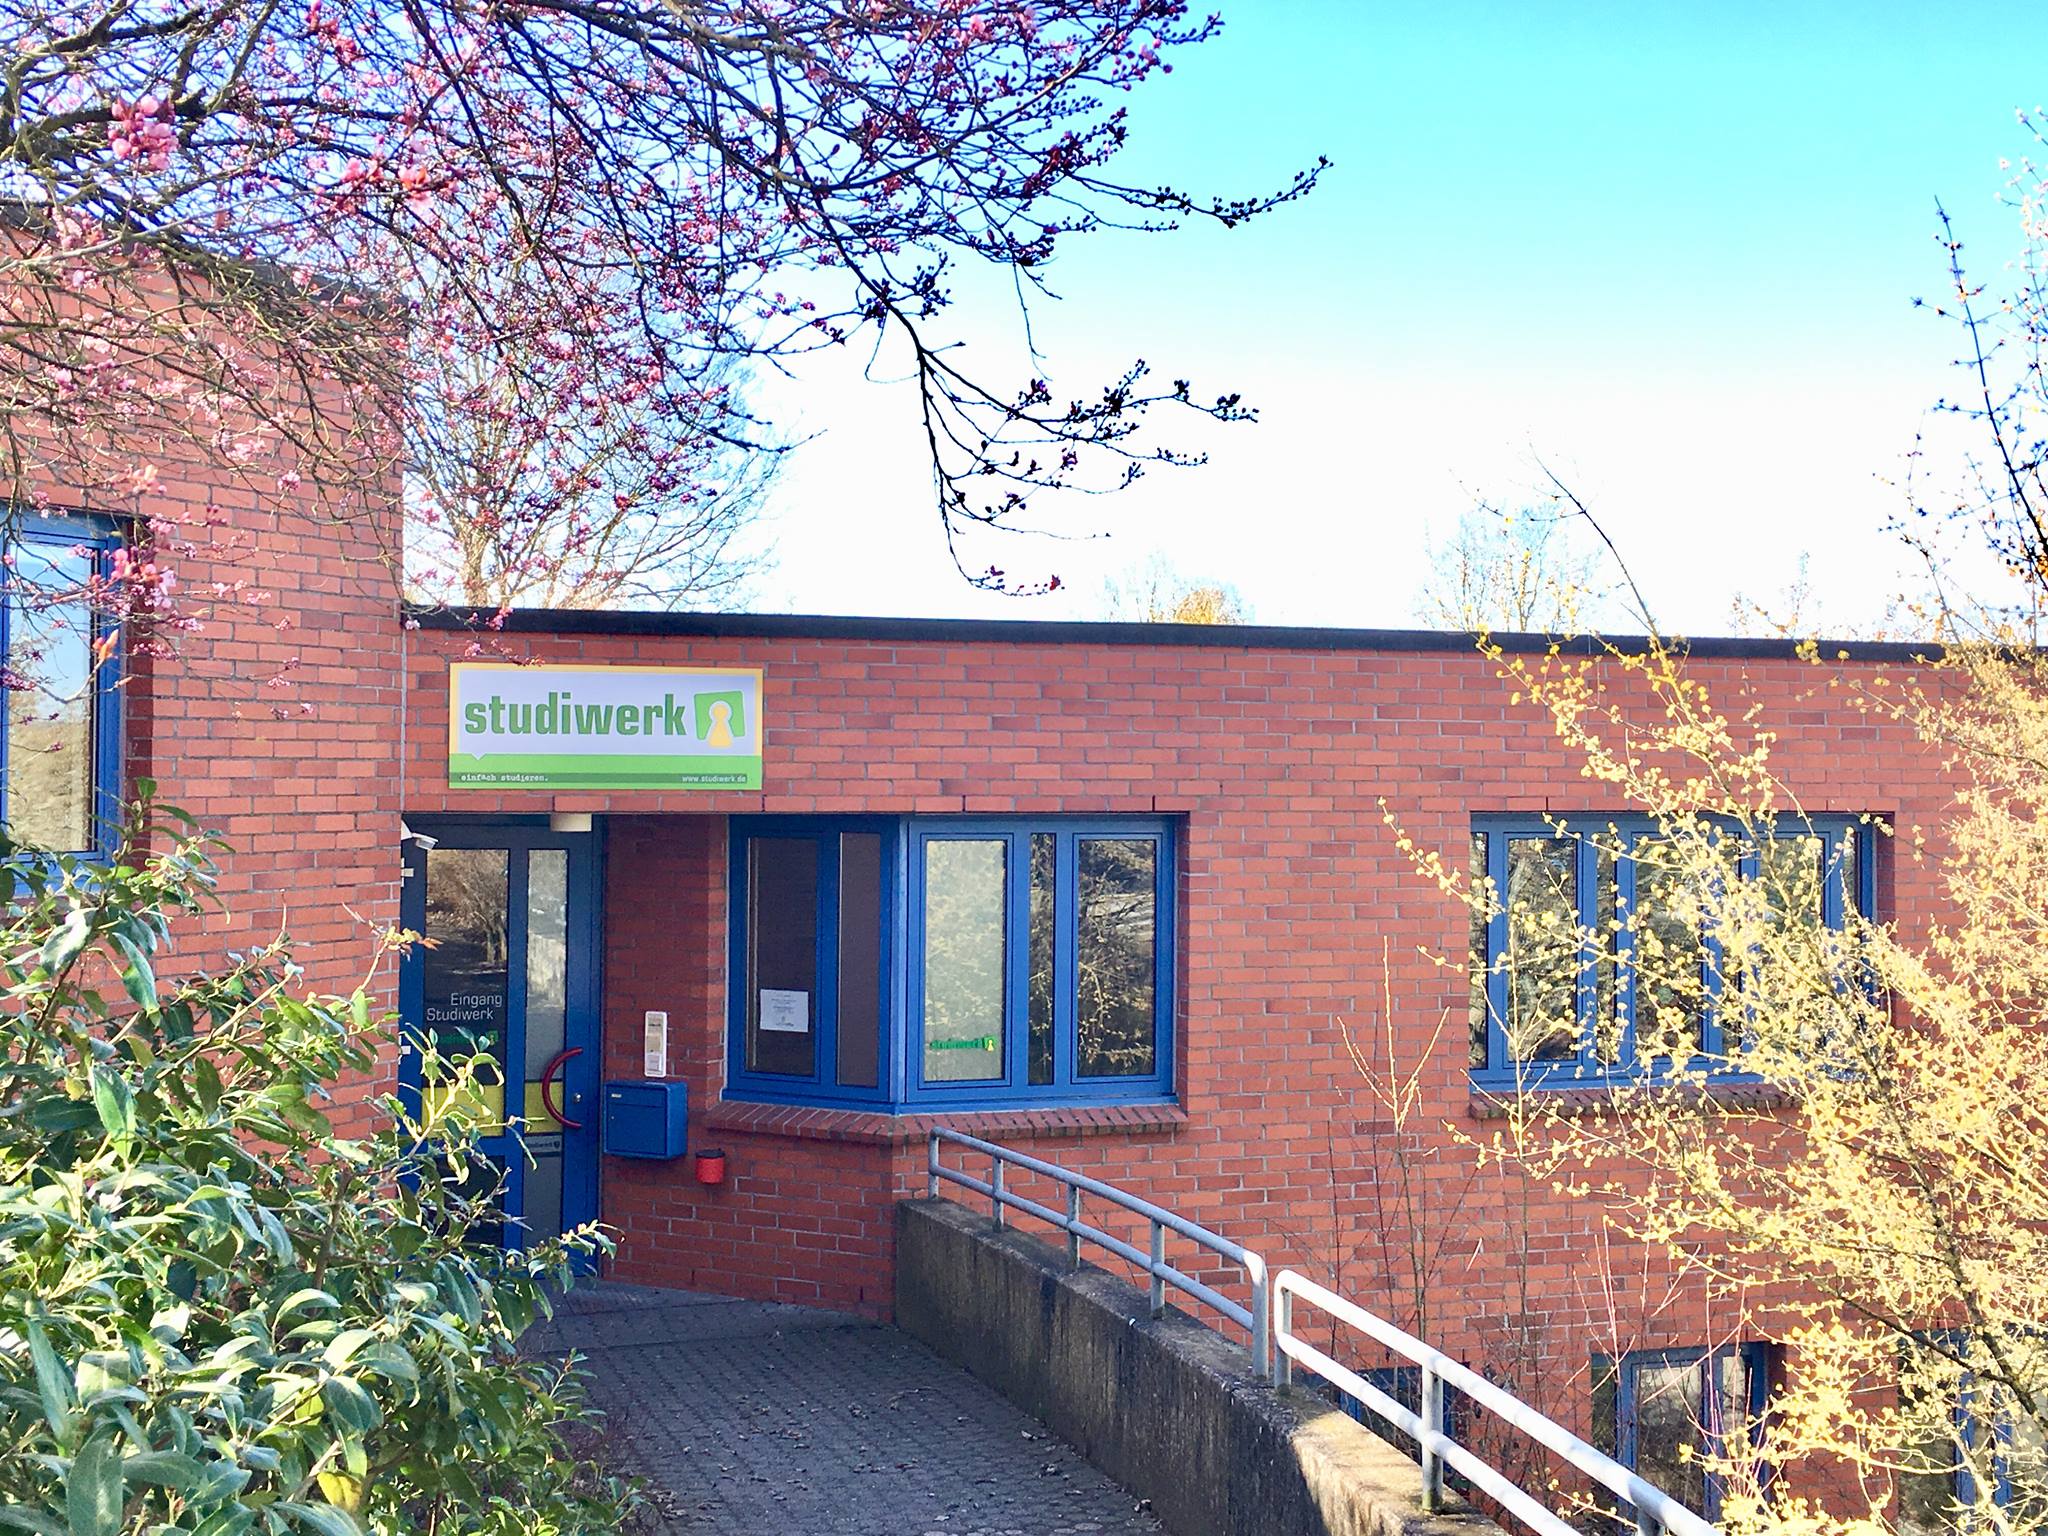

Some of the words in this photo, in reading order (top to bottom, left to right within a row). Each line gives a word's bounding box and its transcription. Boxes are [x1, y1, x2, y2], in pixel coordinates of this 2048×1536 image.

[464, 692, 687, 736] studiwerk
[450, 992, 503, 1009] Eingang
[426, 1007, 494, 1021] Studiwerk
